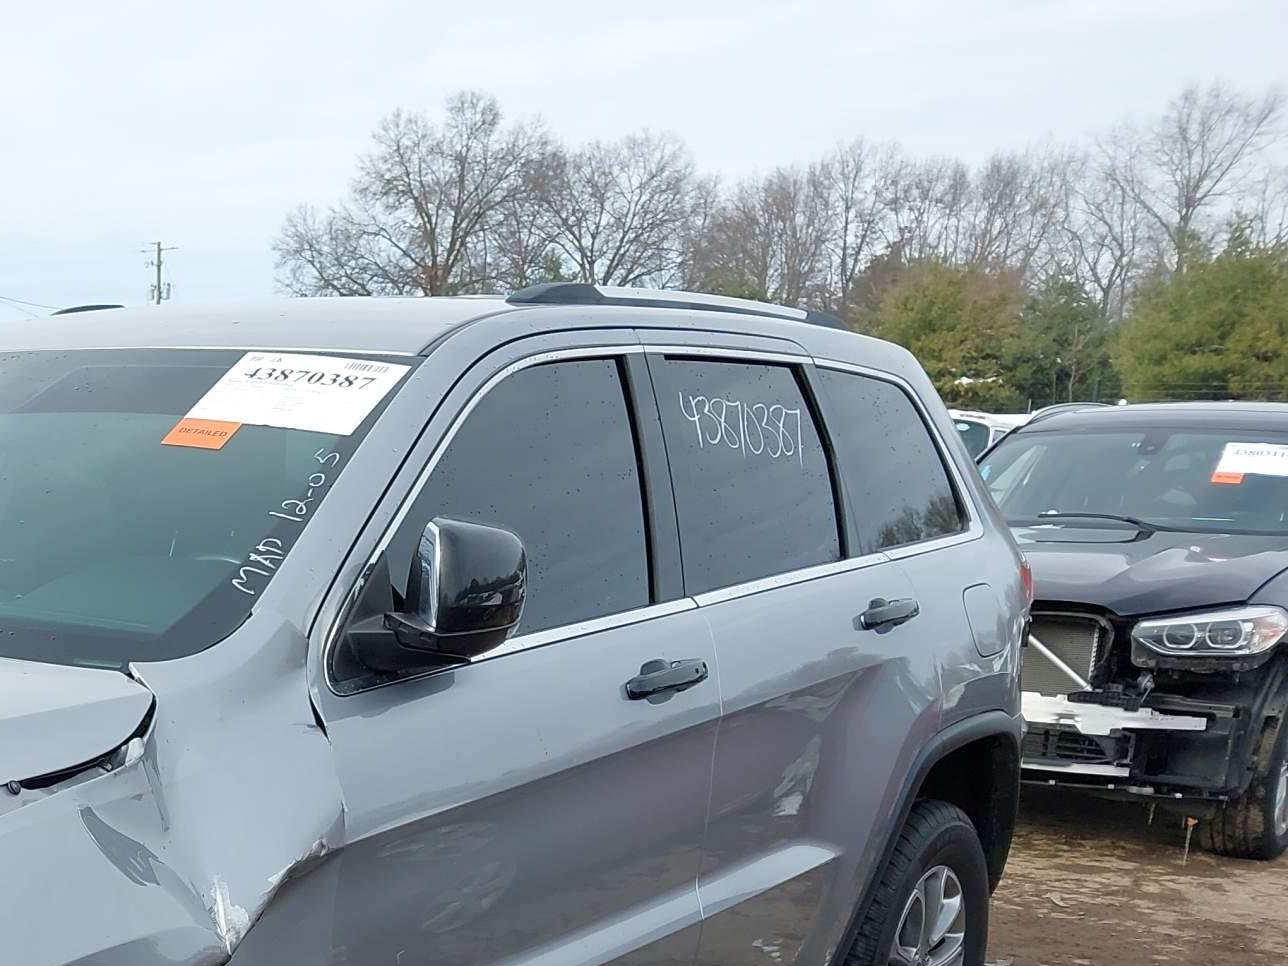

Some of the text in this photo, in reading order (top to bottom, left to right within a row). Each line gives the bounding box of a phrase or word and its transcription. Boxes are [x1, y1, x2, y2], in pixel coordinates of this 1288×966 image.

[244, 367, 377, 390] 43870387
[178, 427, 228, 437] DETAILED
[678, 391, 803, 466] 43870387
